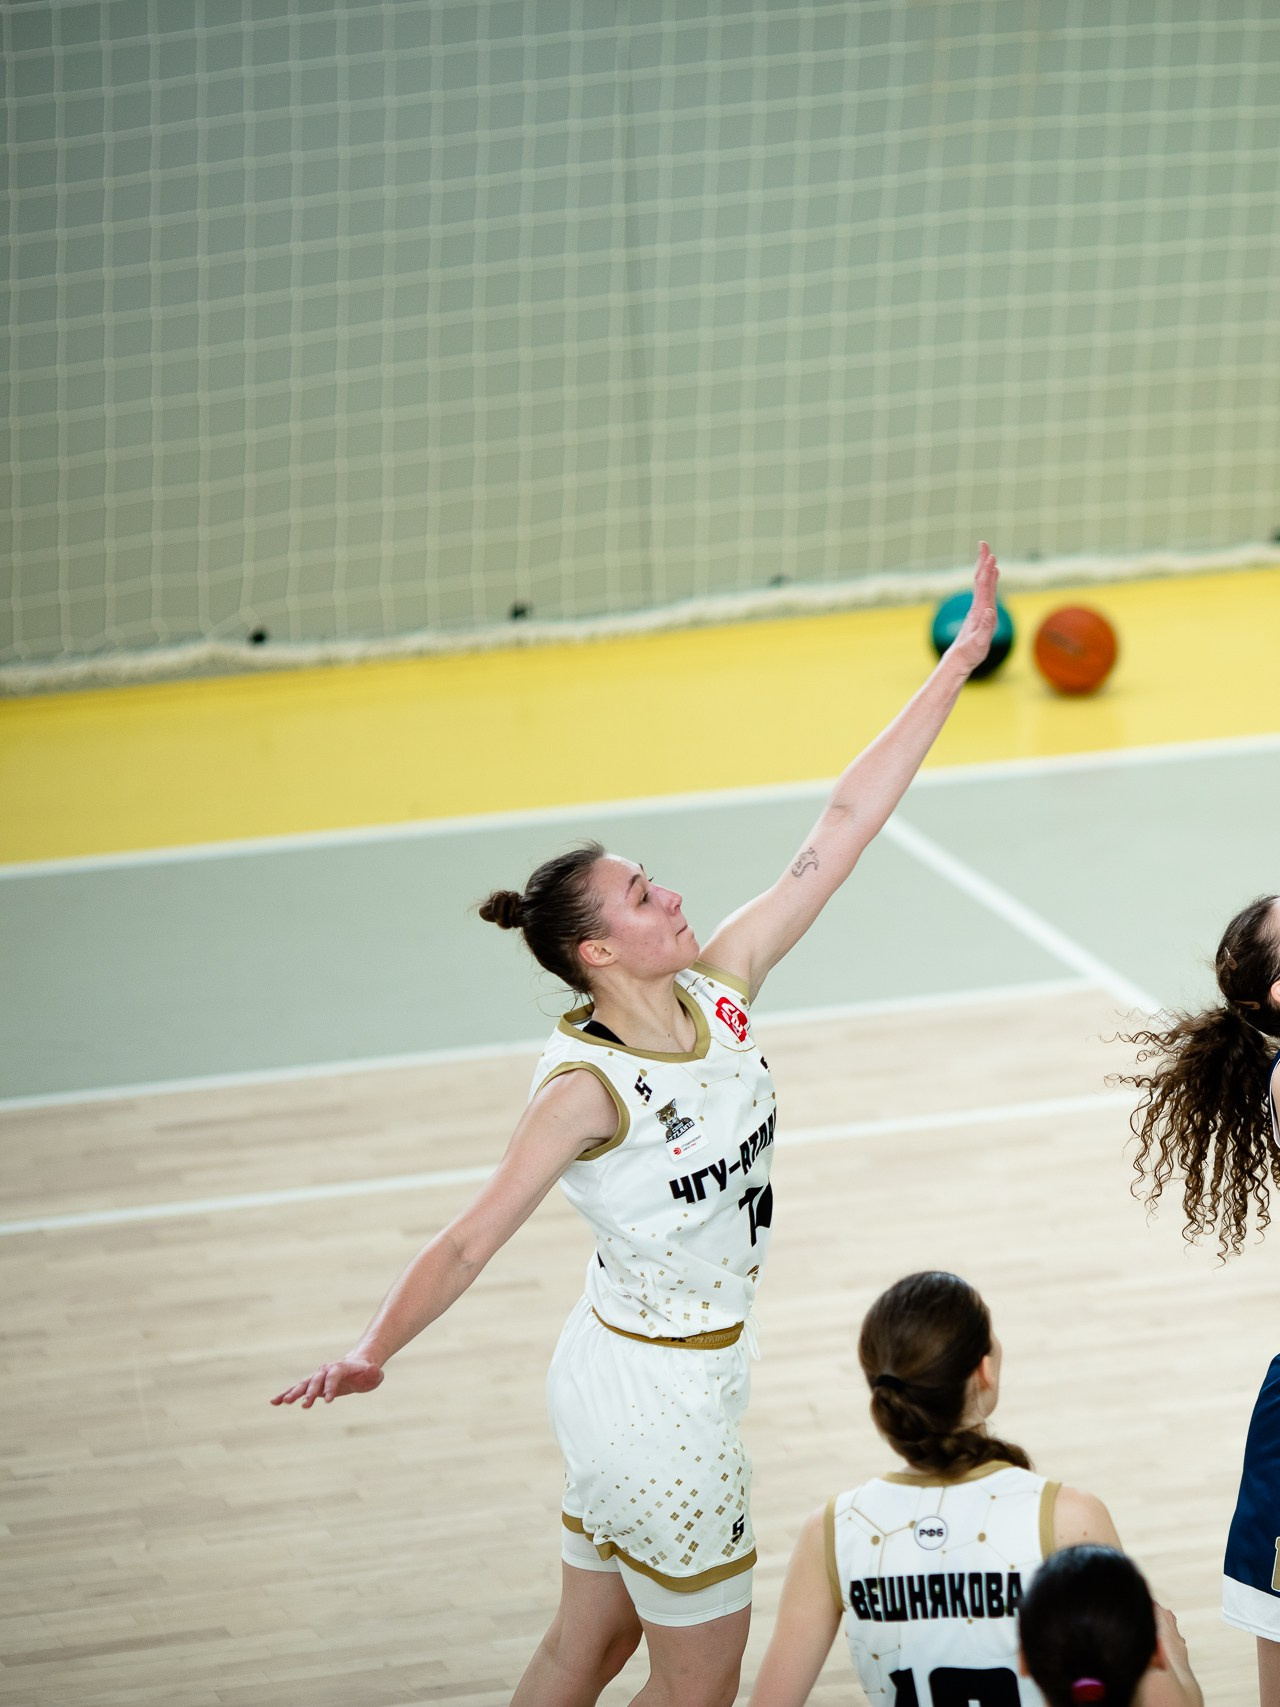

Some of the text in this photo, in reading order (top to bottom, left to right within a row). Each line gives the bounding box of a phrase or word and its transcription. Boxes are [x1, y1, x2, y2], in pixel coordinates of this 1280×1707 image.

[669, 1107, 777, 1204] ЧГУ-АТЛА
[919, 1528, 945, 1538] РФБ
[849, 1572, 1023, 1622] ВЕШНЯКОВА
